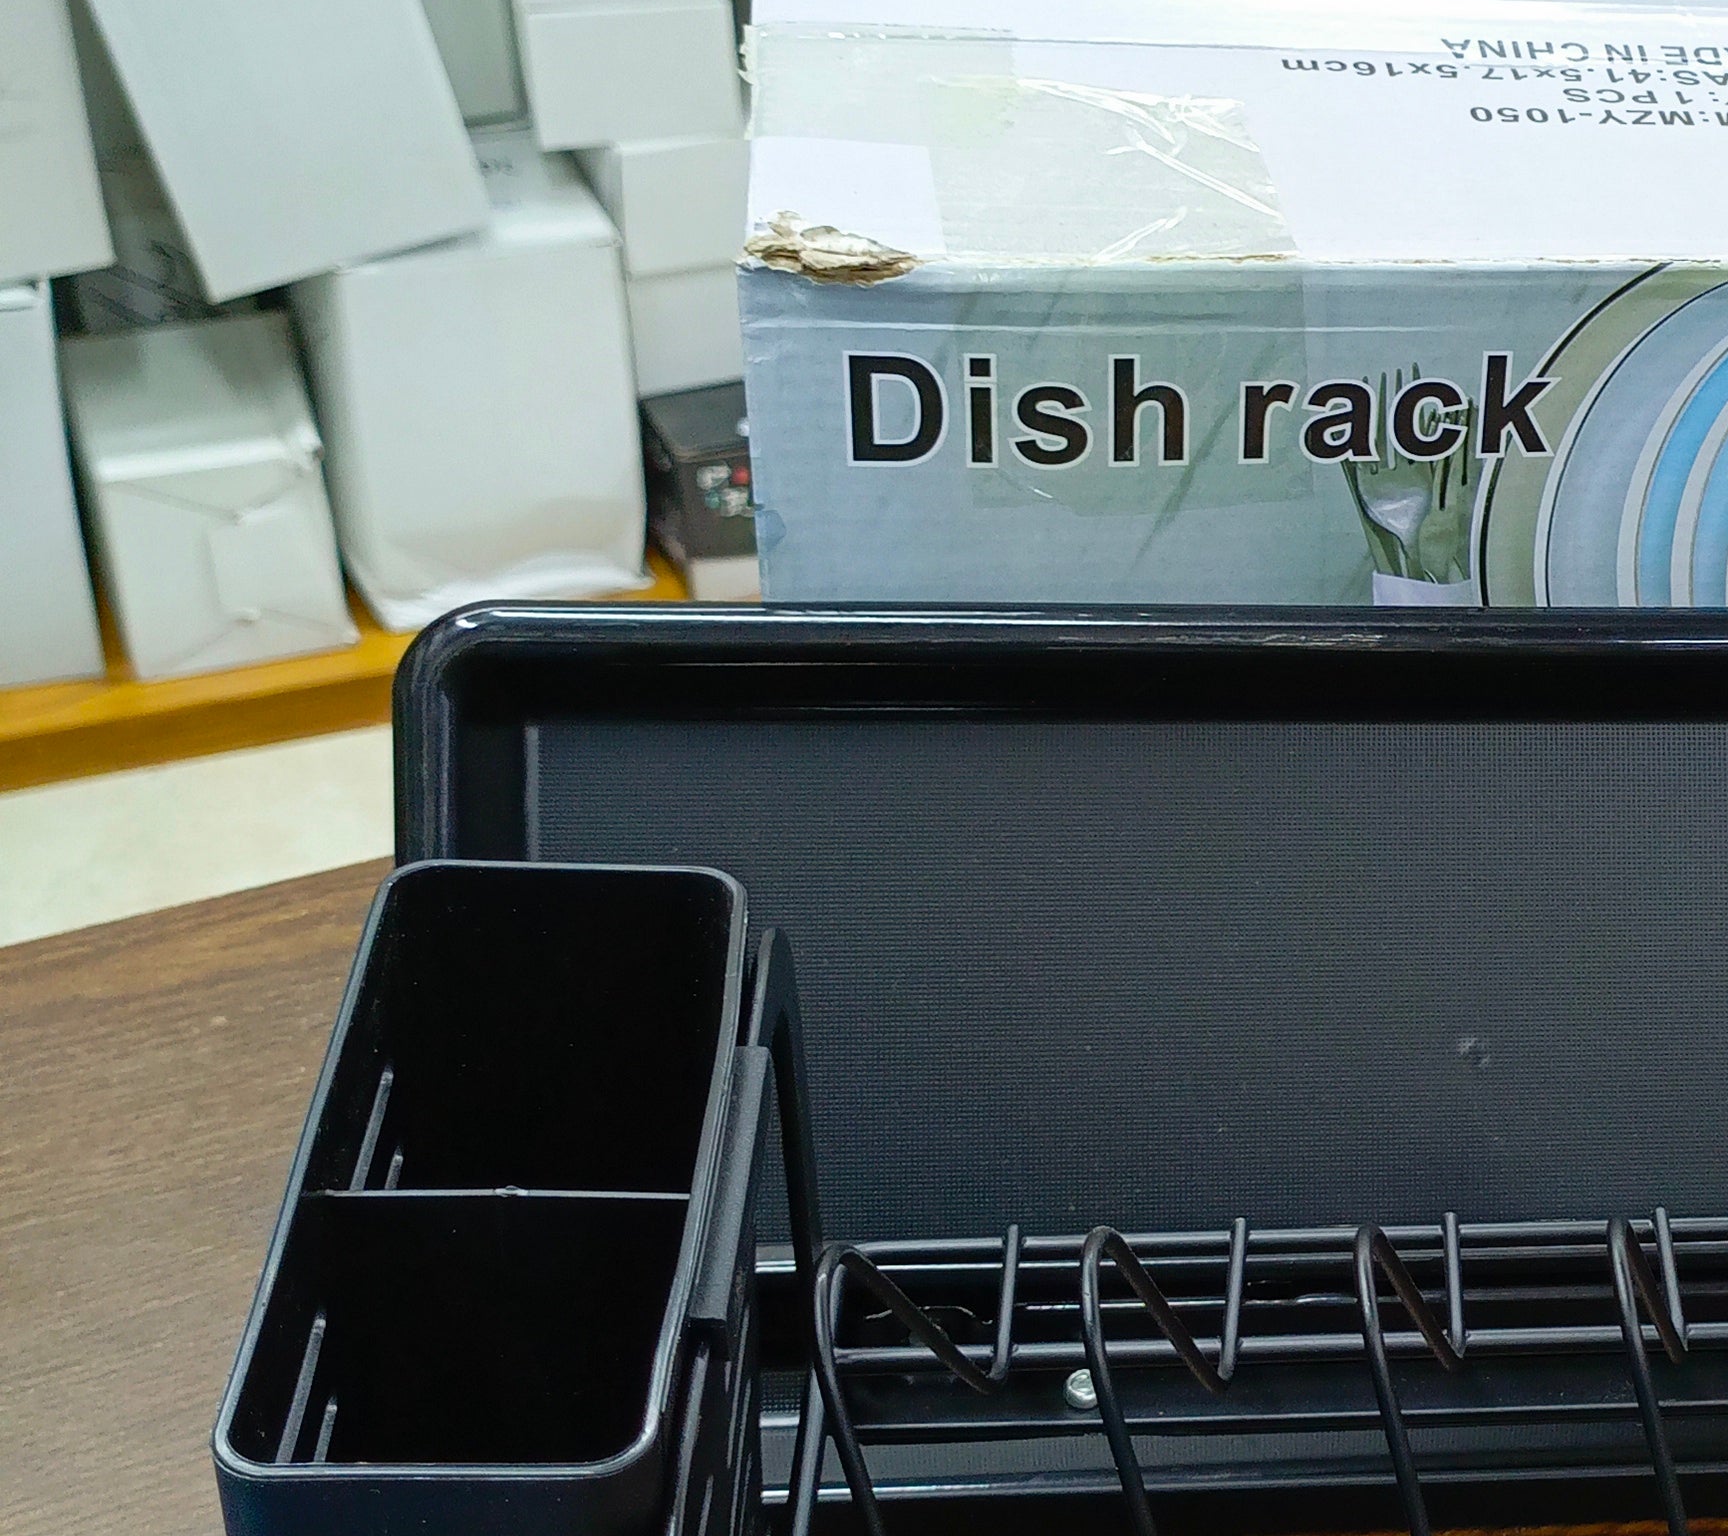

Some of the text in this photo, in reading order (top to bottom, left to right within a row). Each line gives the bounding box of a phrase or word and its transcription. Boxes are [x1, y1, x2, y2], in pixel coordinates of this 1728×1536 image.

[1440, 38, 1590, 62] CHINA
[1604, 43, 1649, 63] IN
[1563, 87, 1659, 104] PCS
[1675, 90, 1693, 105] 1
[843, 350, 1561, 467] Dish rack
